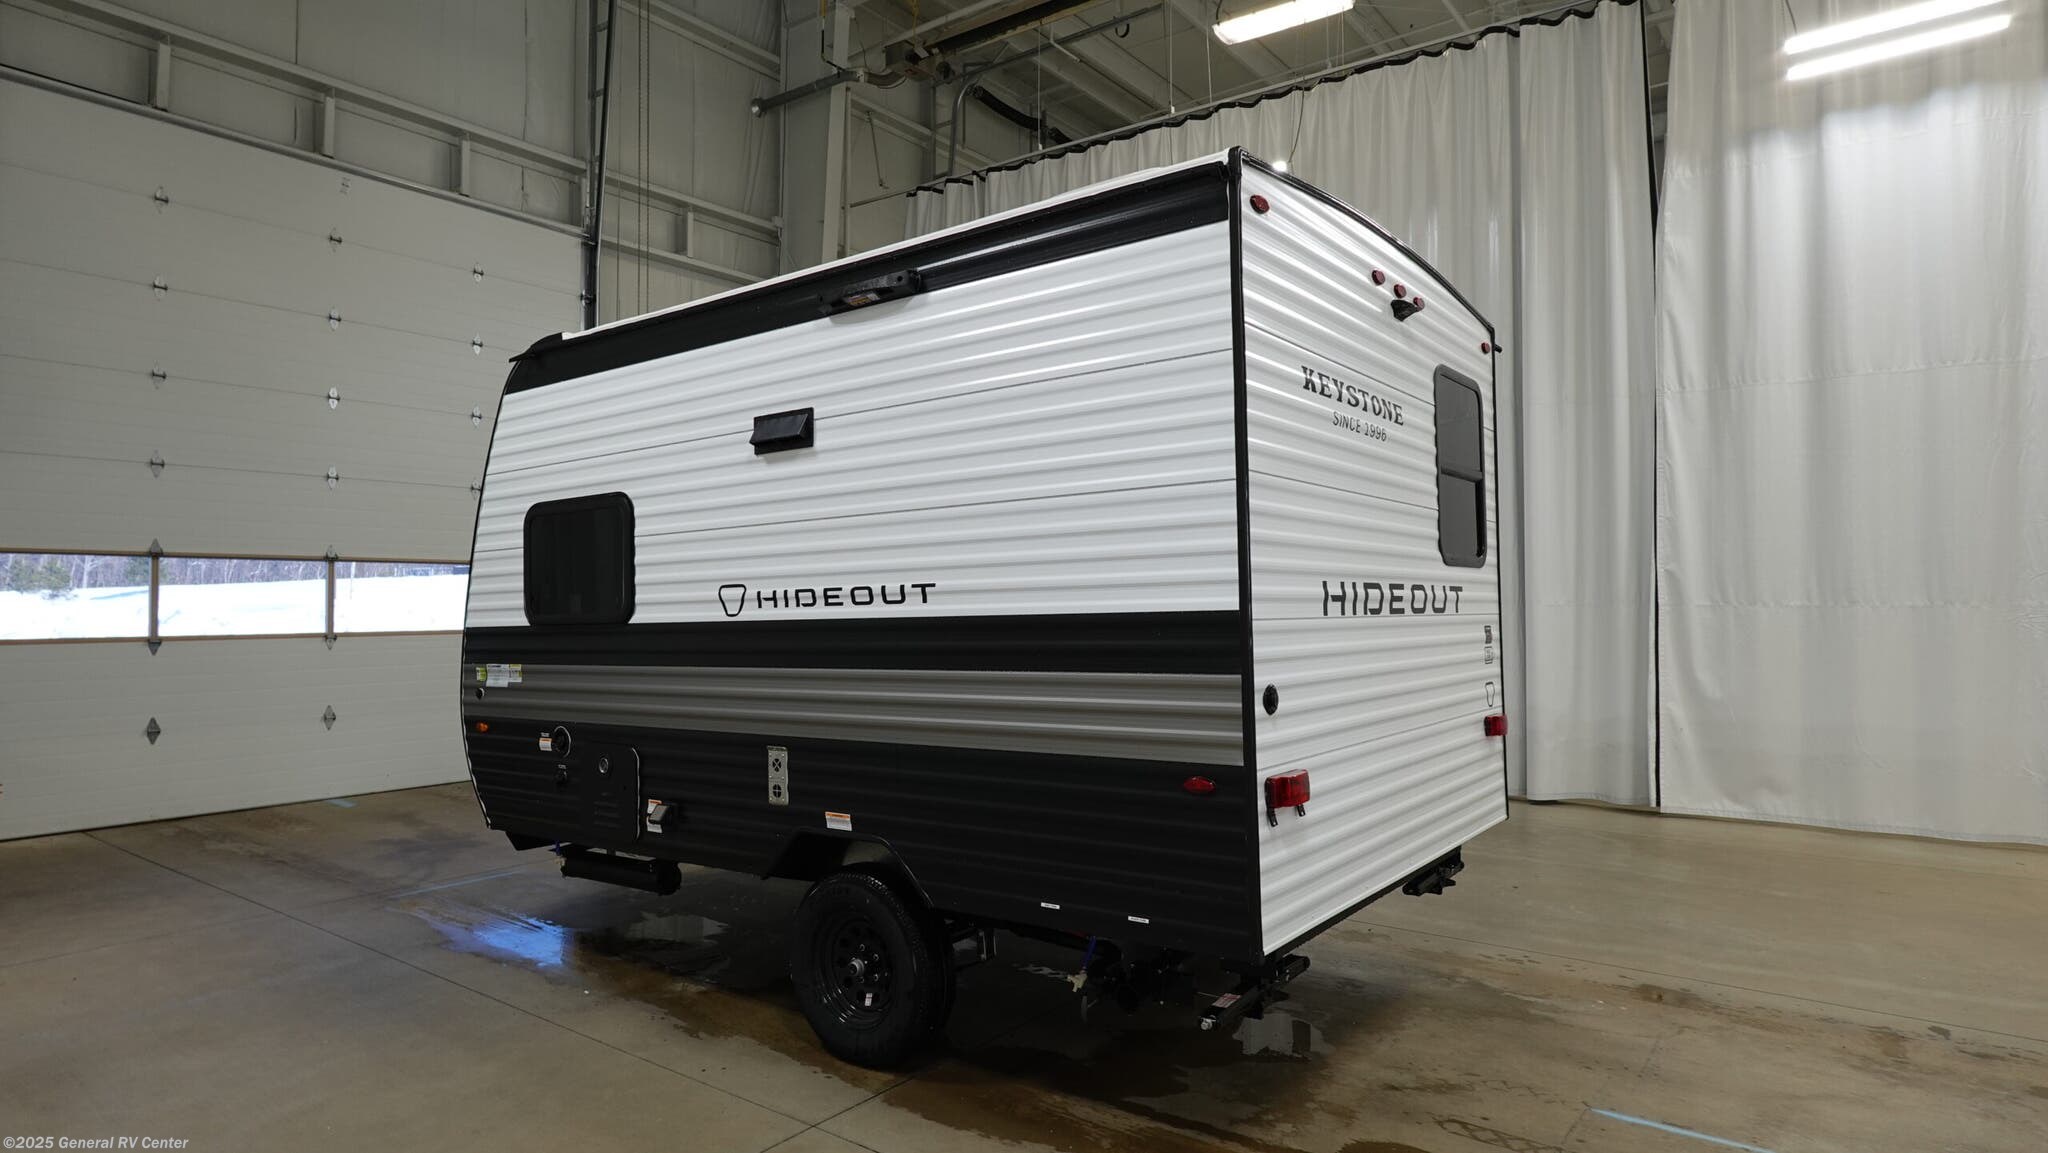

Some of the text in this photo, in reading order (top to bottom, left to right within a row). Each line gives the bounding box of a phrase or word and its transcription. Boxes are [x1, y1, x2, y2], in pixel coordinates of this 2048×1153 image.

[1301, 365, 1404, 426] KEYSTONE
[1332, 411, 1387, 442] SINCE 1996
[756, 583, 936, 609] HIDEOUT
[1322, 580, 1463, 616] HIDEOUT
